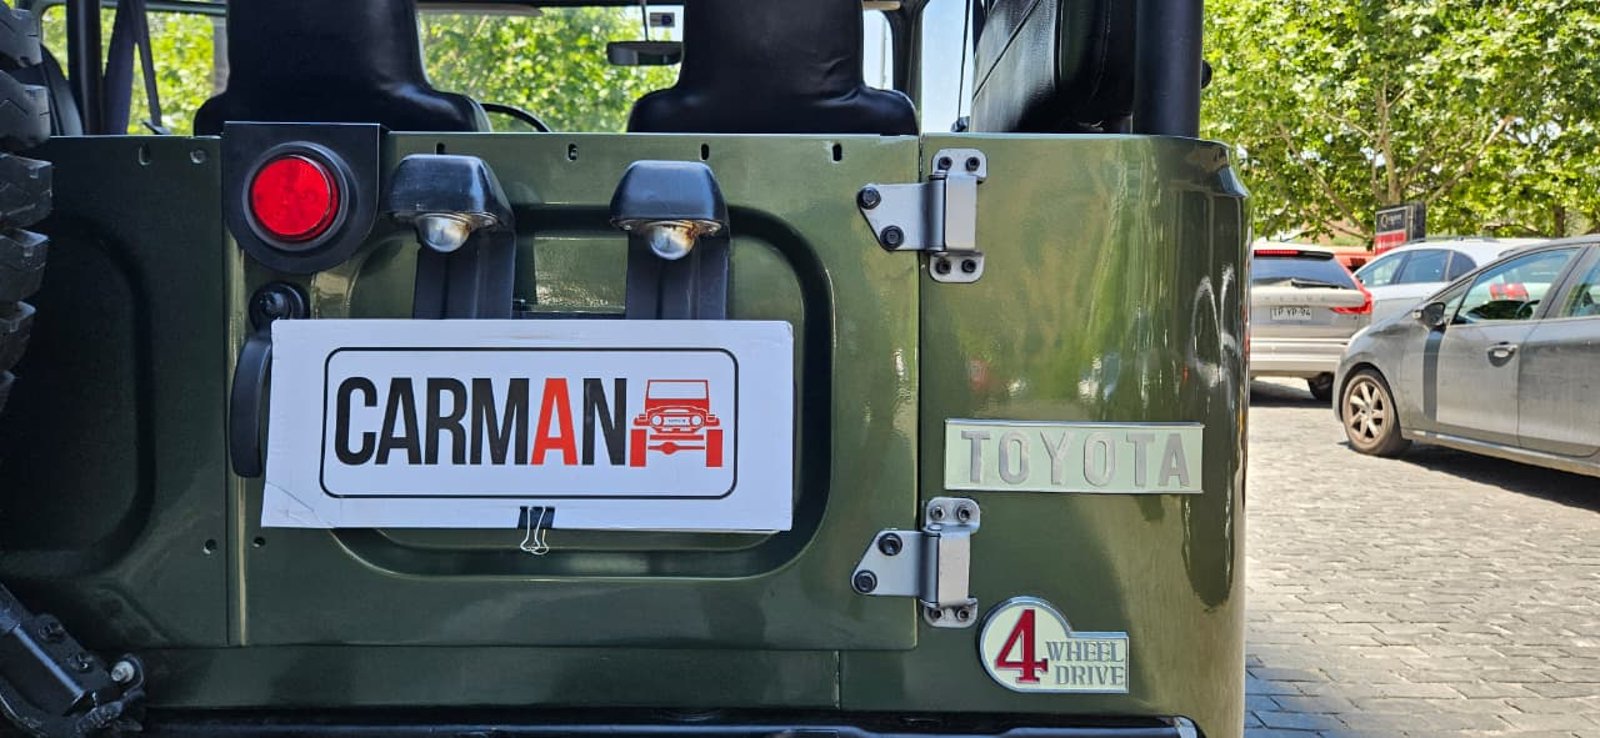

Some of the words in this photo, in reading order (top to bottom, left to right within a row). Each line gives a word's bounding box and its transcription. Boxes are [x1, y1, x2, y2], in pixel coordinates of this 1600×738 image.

[334, 376, 628, 466] CARMAN
[961, 430, 1190, 488] TOYOTA
[994, 608, 1048, 684] 4
[1046, 640, 1124, 662] WHEEL
[1055, 665, 1124, 685] DRIVE
